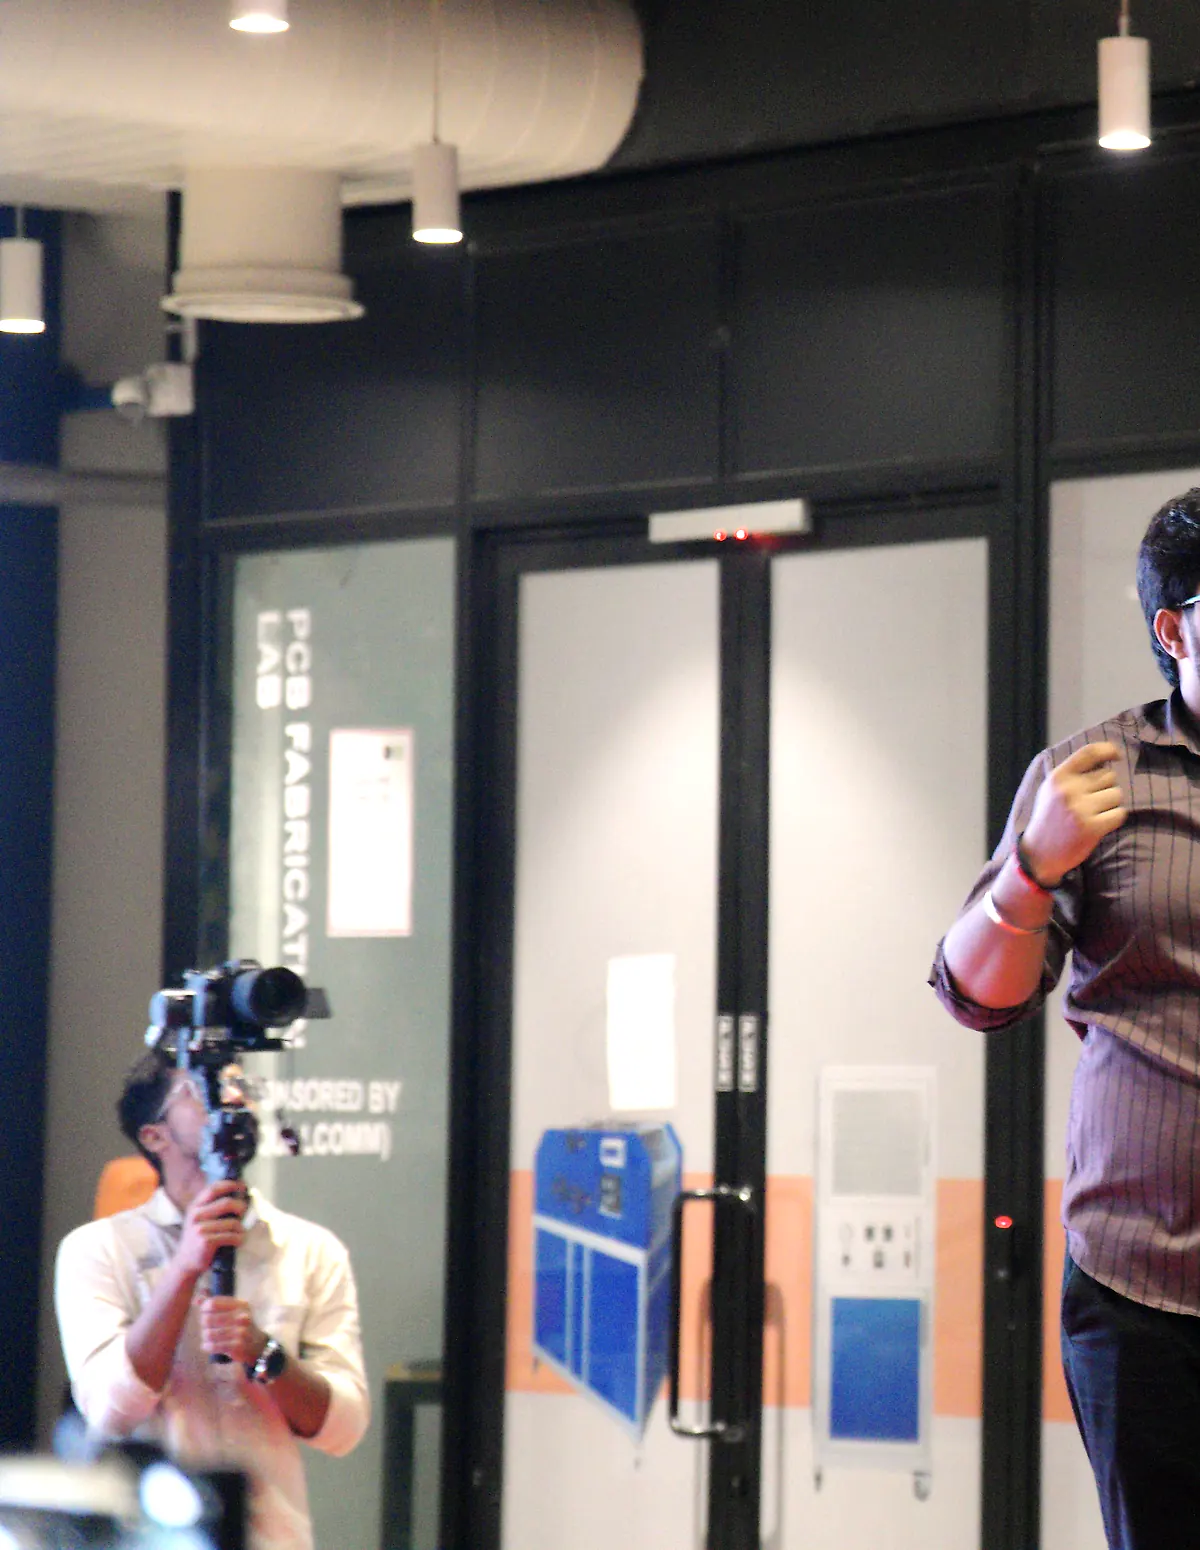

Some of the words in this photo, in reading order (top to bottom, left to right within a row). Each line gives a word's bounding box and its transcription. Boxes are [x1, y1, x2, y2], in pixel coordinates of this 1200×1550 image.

[256, 611, 282, 709] LAB
[285, 607, 311, 710] PCB
[283, 722, 311, 1049] FABRICATIN
[369, 1081, 402, 1114] BY
